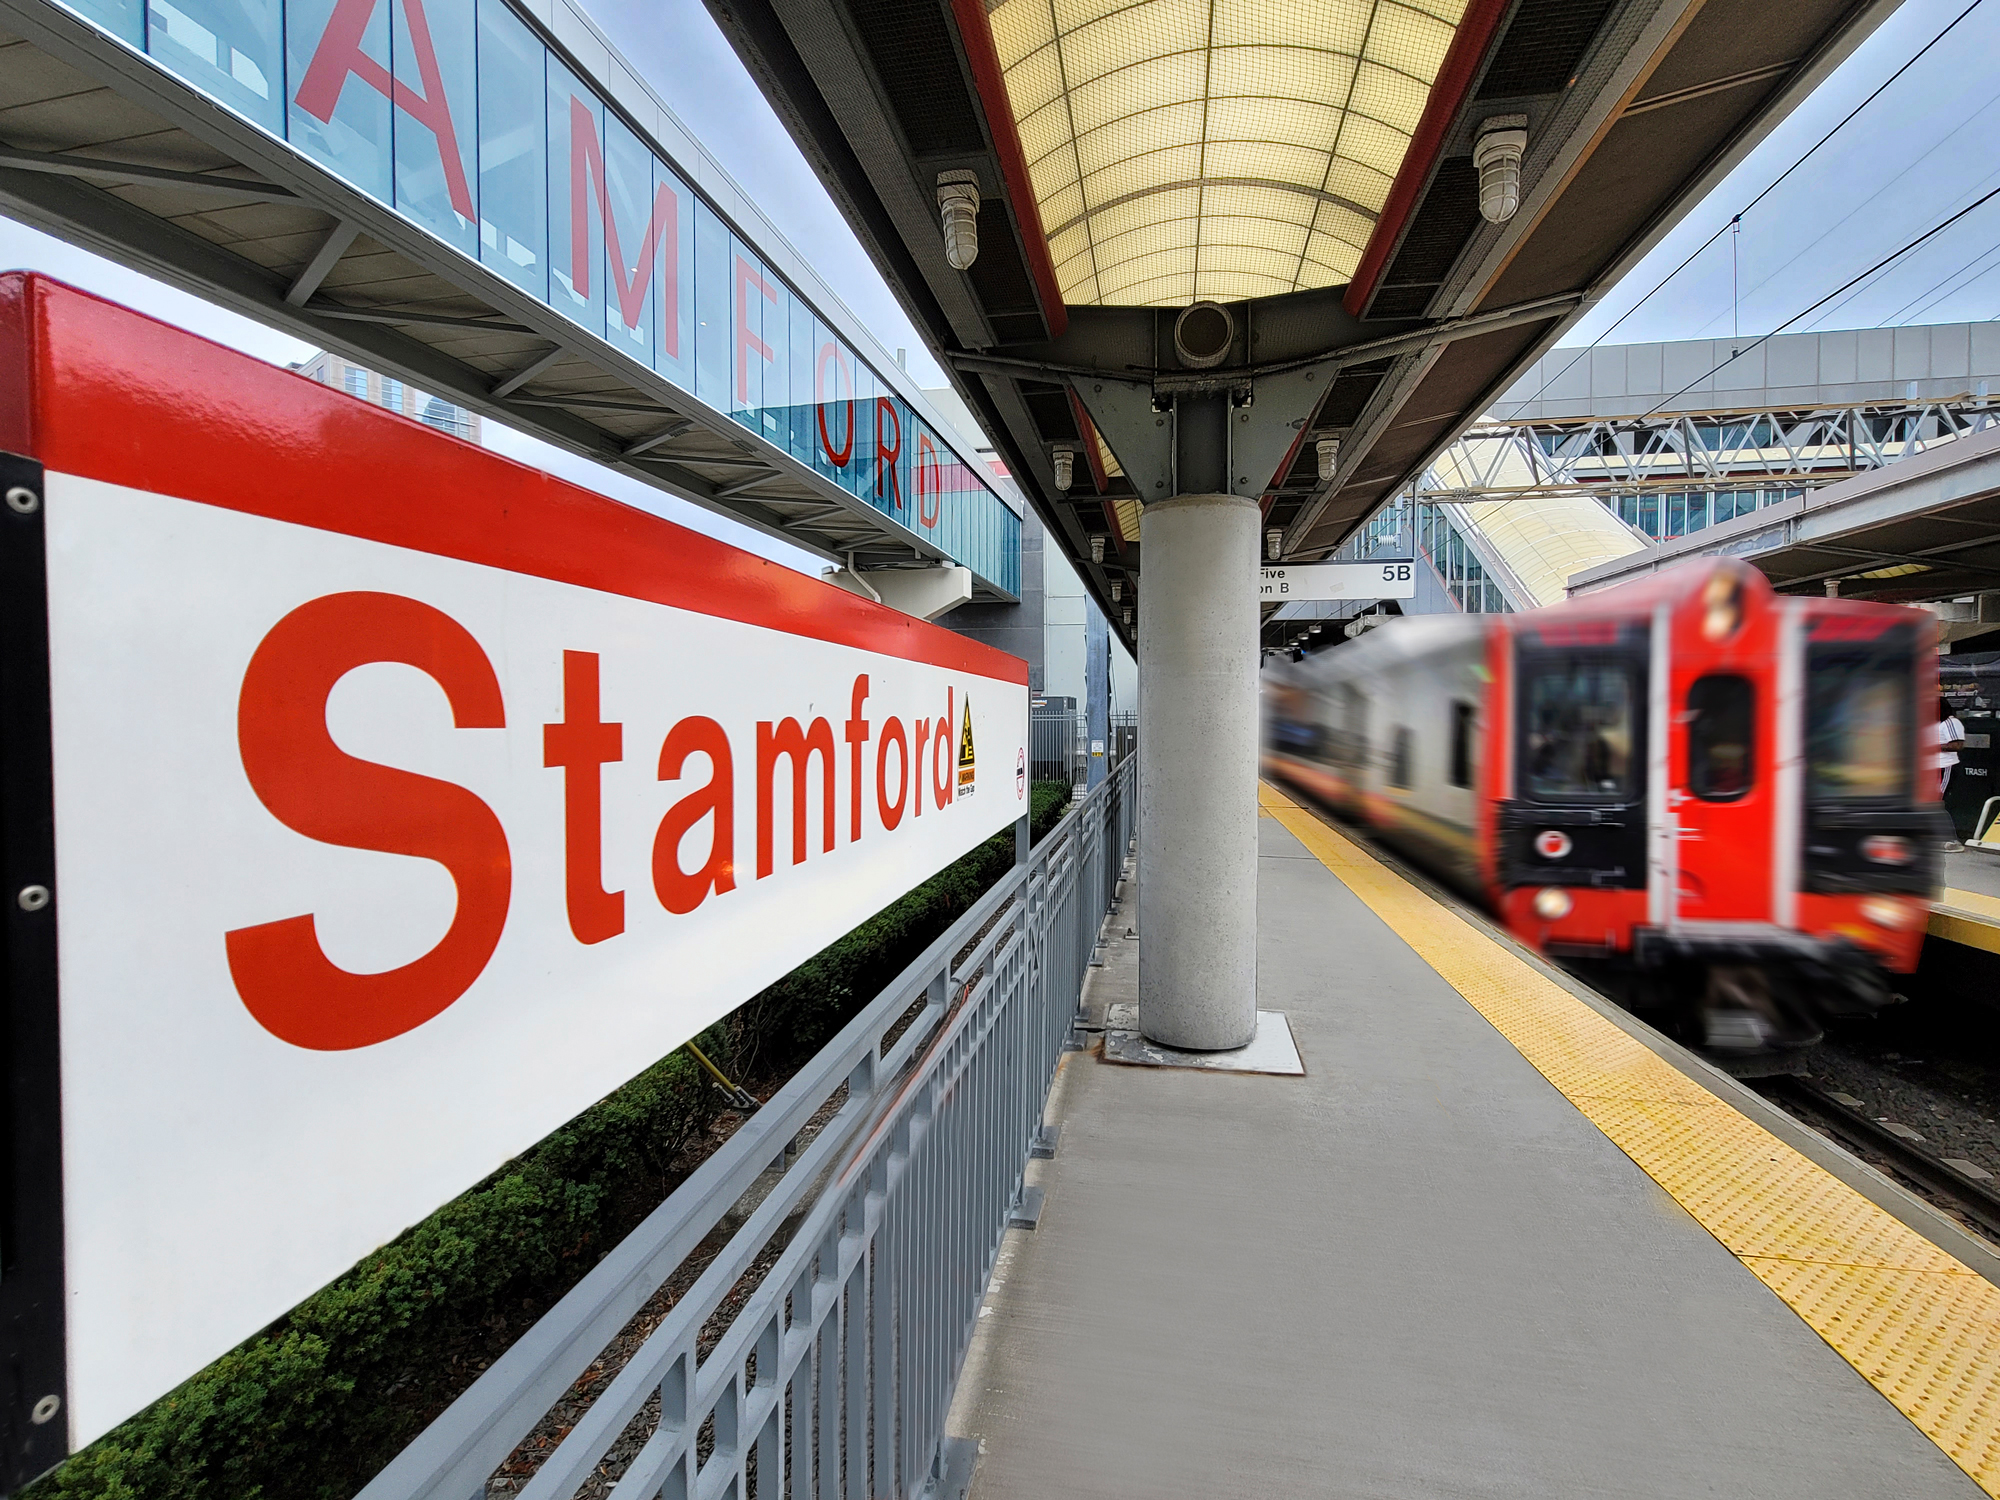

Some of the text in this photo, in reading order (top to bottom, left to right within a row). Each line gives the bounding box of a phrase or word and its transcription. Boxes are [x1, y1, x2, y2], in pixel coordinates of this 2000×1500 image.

[1382, 565, 1411, 581] 5B
[1280, 582, 1290, 594] B
[1964, 767, 1988, 777] TRASH
[225, 591, 954, 1051] Stamford
